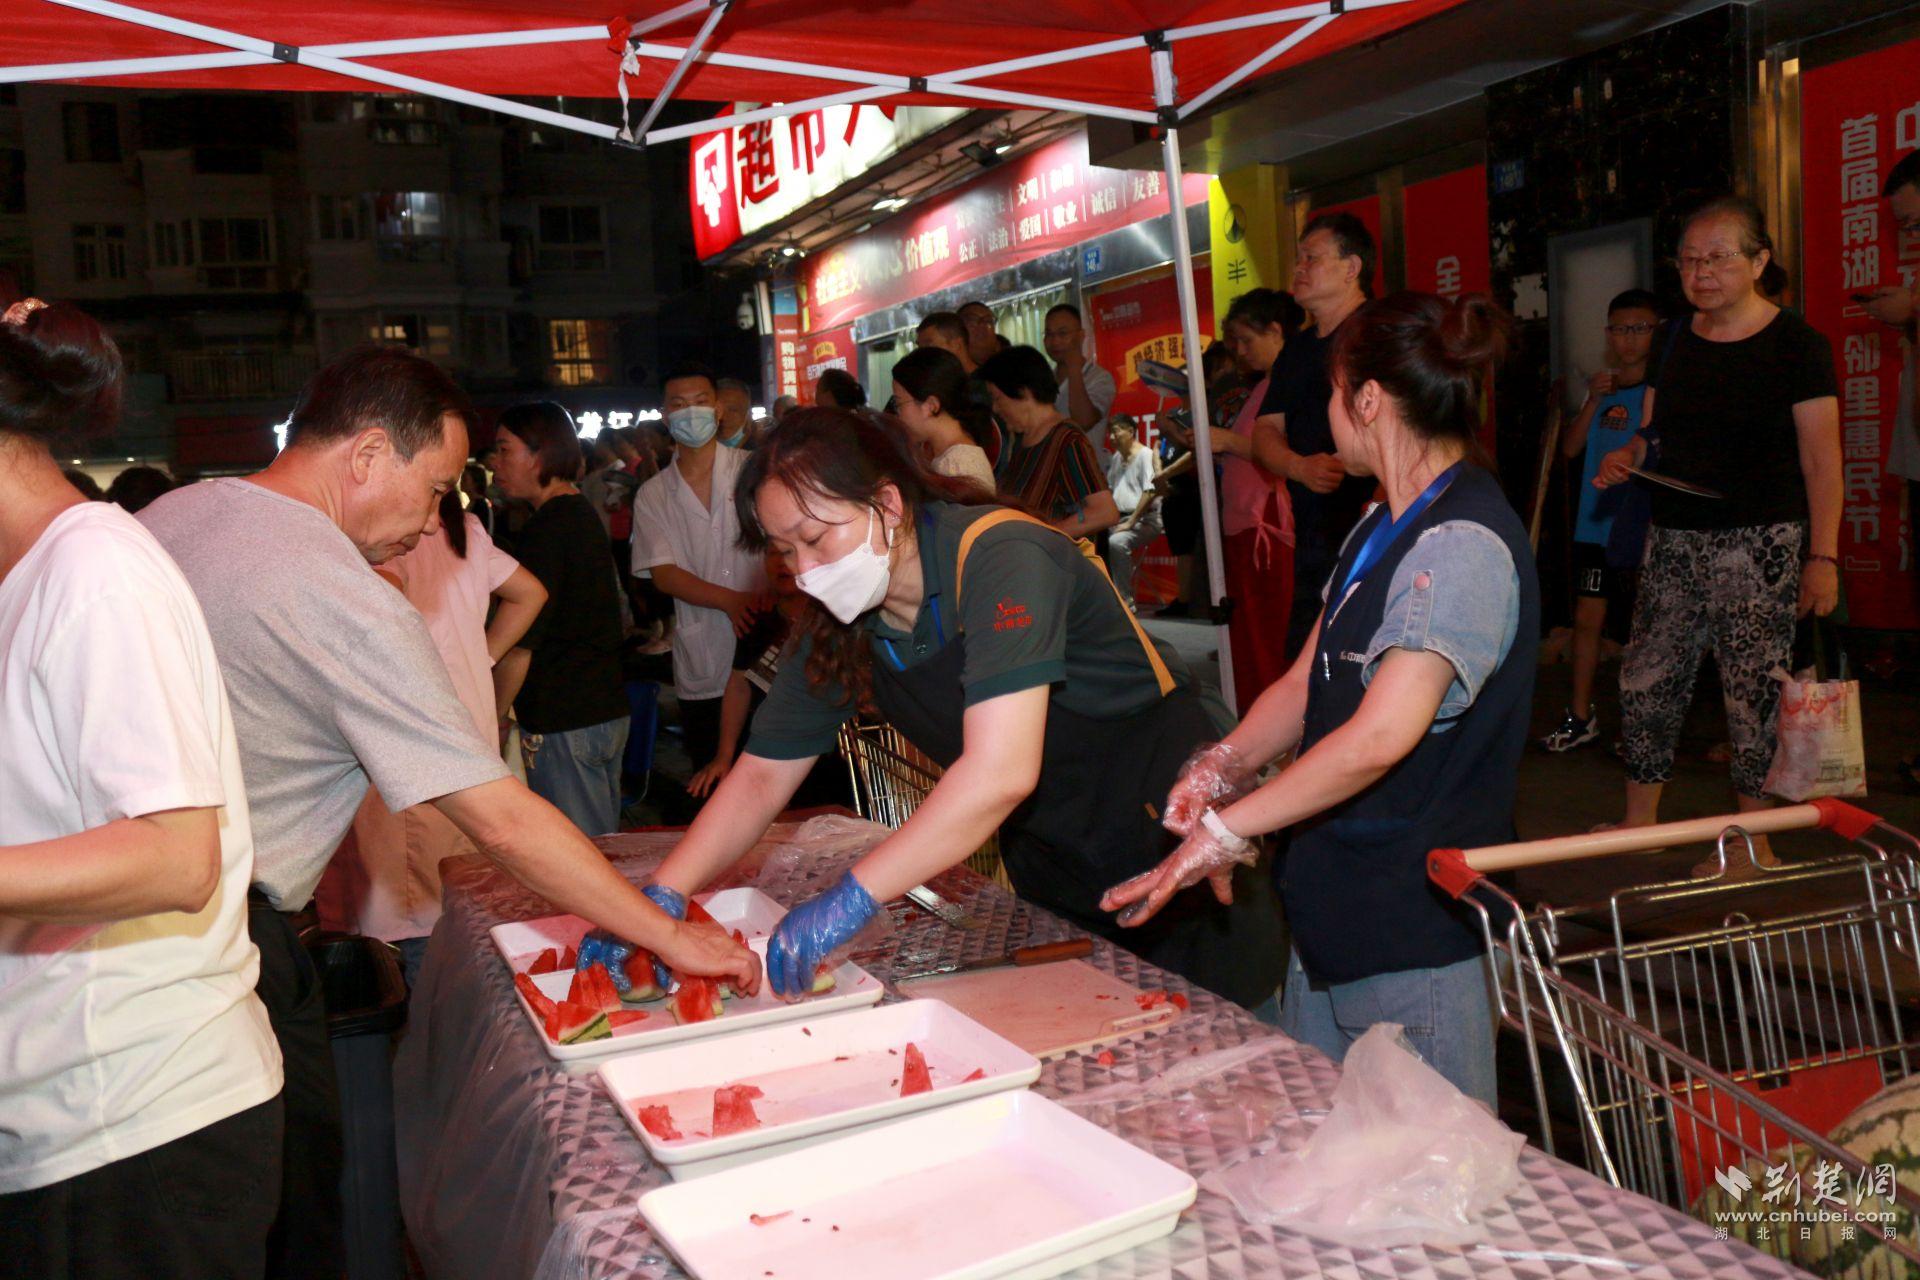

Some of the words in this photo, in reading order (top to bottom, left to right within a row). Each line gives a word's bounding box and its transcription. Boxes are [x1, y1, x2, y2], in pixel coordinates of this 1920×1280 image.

[737, 103, 895, 209] 超市
[1016, 177, 1039, 207] 文明
[988, 230, 1009, 252] 法治
[1019, 213, 1042, 242] 爱国
[1052, 200, 1078, 229] 敬业
[1090, 187, 1118, 216] 诚信
[1132, 170, 1160, 202] 友善
